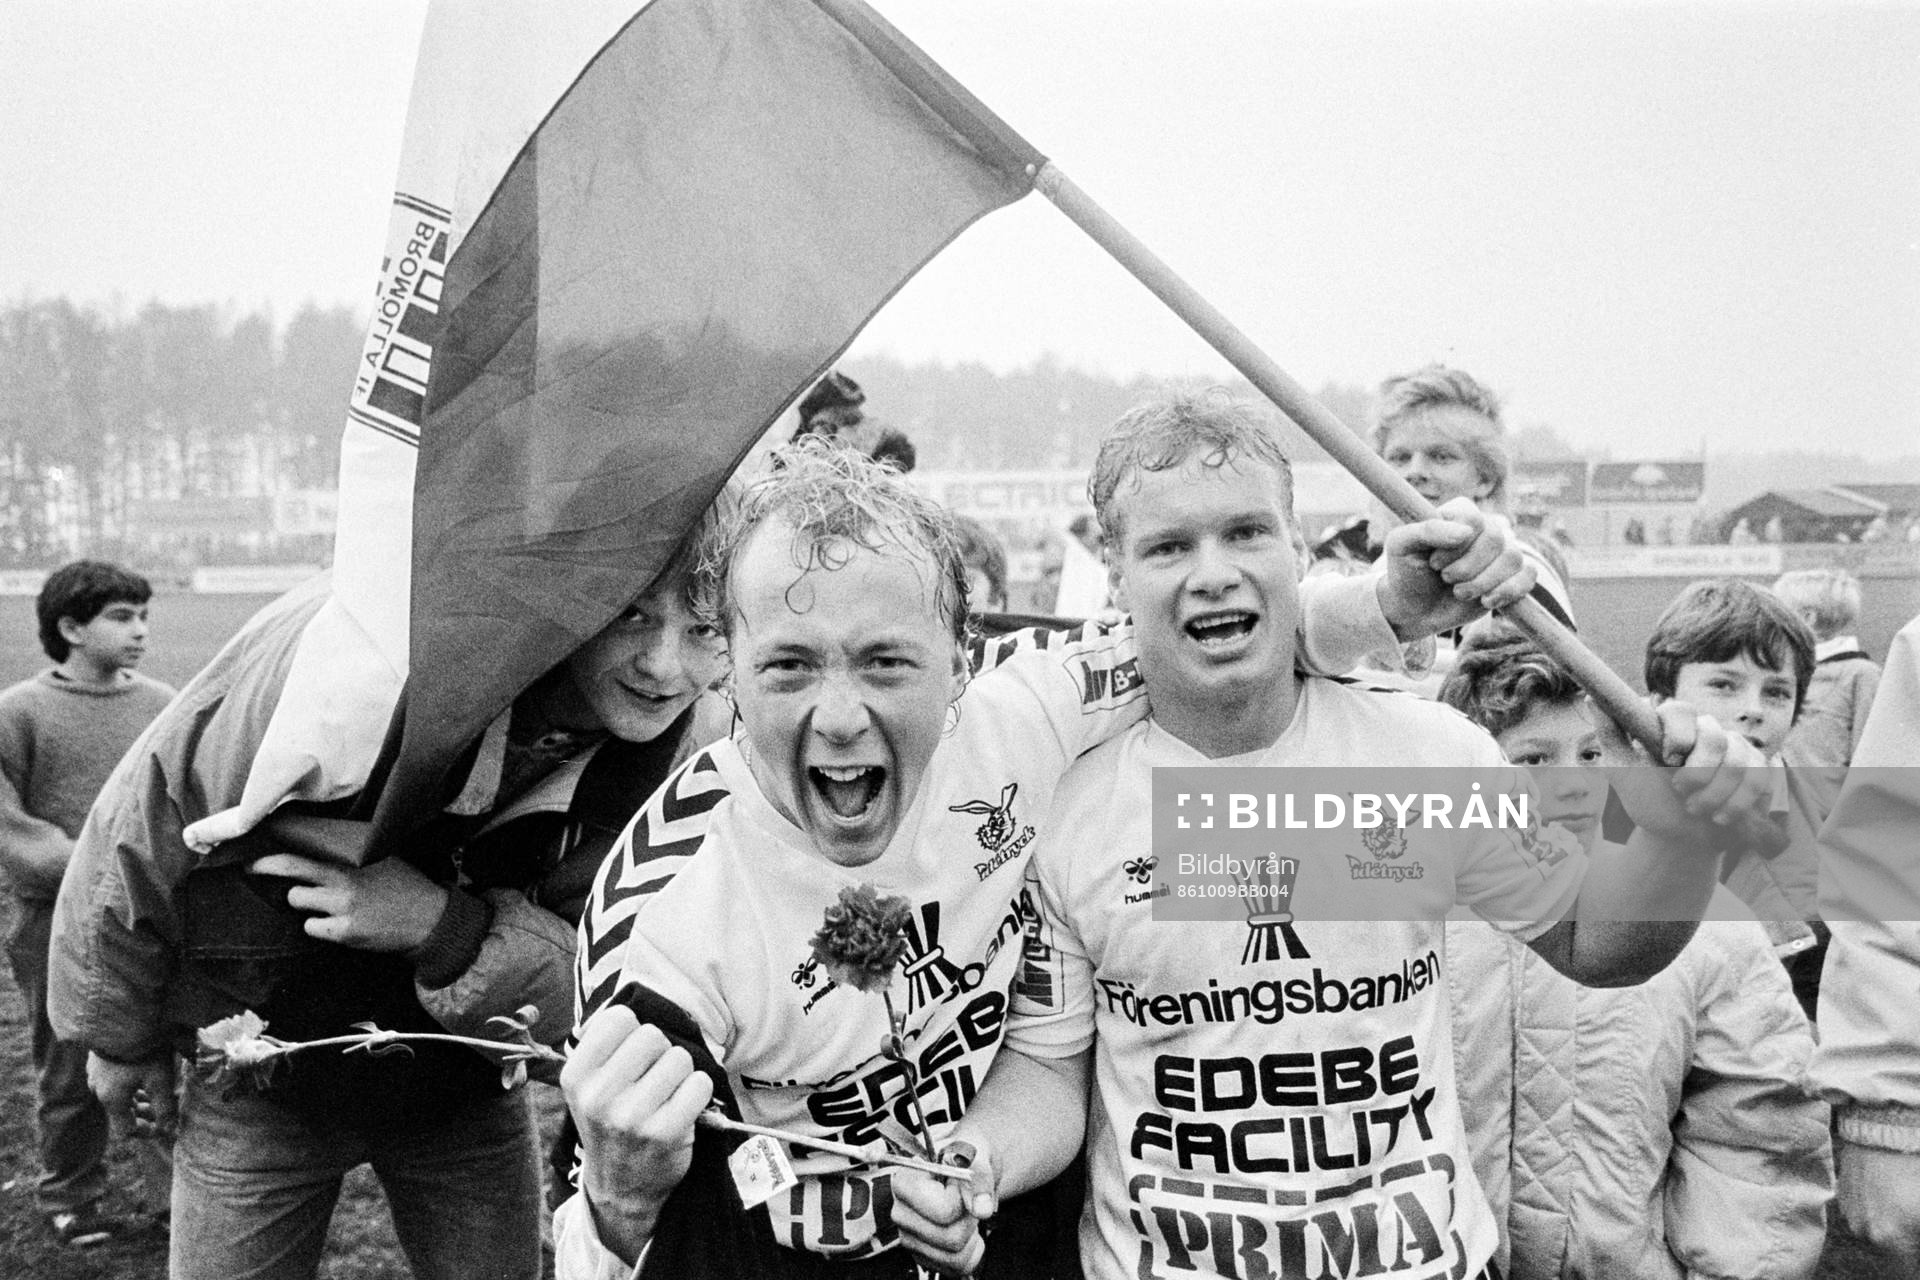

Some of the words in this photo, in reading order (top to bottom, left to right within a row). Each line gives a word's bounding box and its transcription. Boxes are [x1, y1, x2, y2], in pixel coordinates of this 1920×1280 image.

[1097, 949, 1440, 1026] Föreningsbanken
[1154, 1034, 1420, 1112] EDEBE
[1130, 1087, 1436, 1174] FACILITY
[1151, 1191, 1444, 1280] PRIMA
